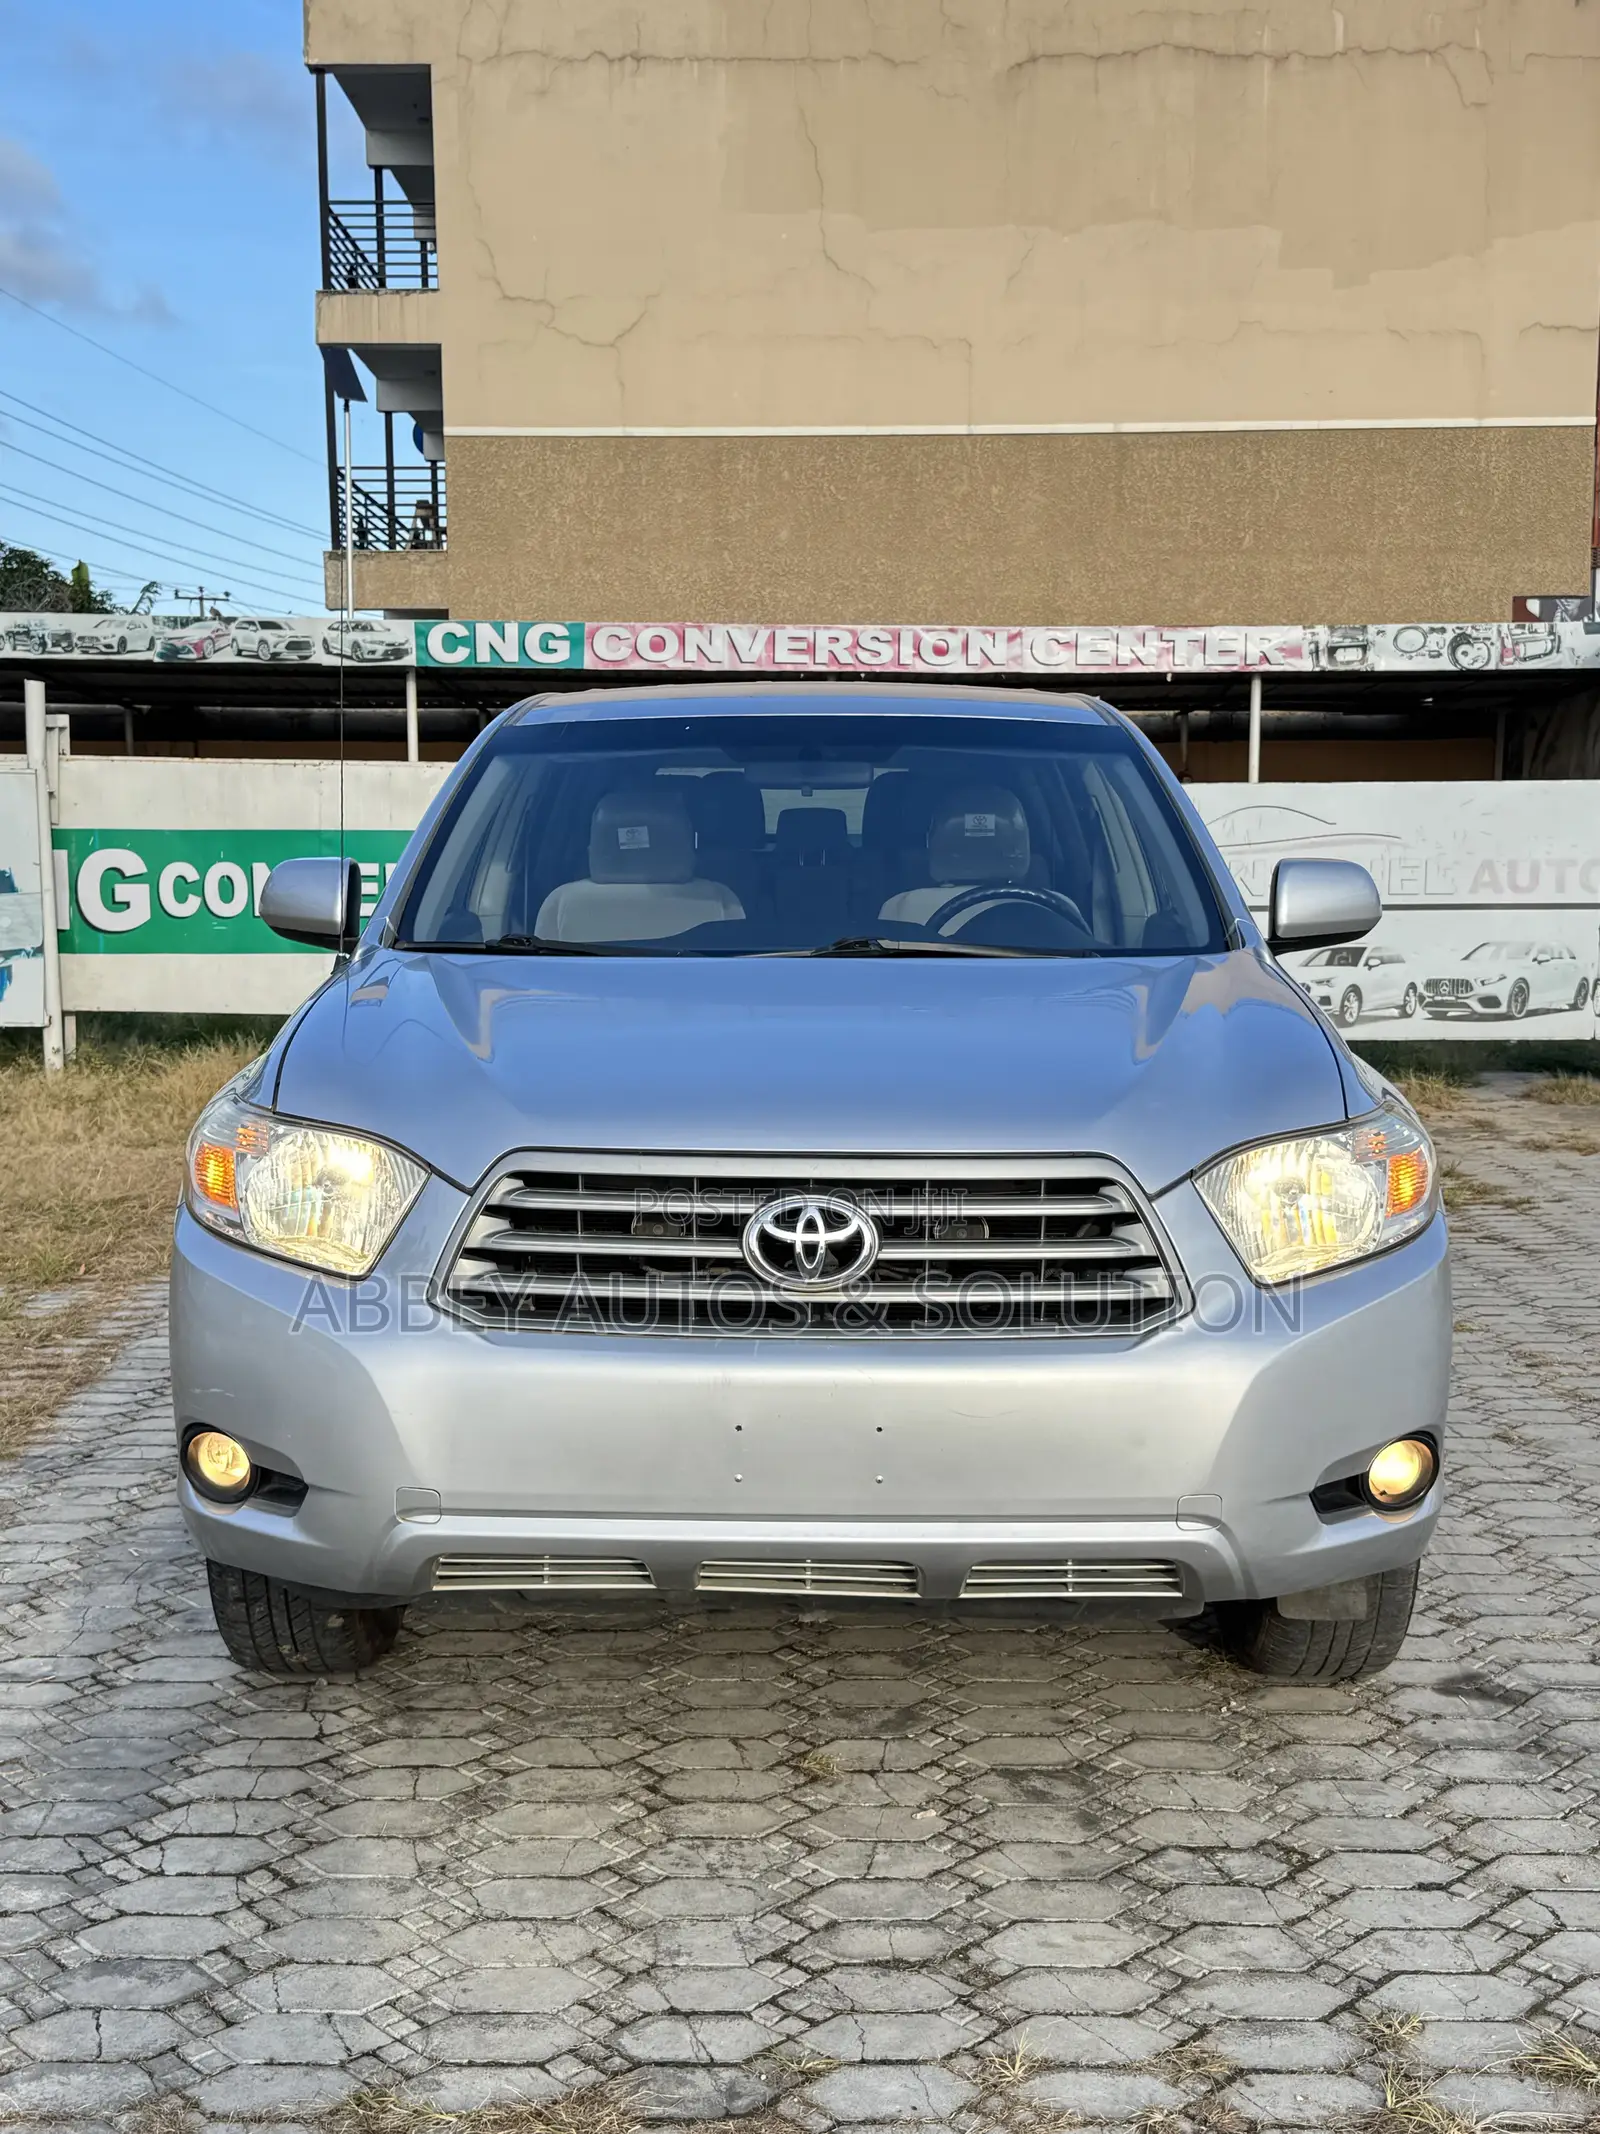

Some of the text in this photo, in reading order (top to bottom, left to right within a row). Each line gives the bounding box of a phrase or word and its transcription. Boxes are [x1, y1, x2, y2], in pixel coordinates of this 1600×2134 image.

[426, 622, 1286, 667] CNG CONVERSION CENTER
